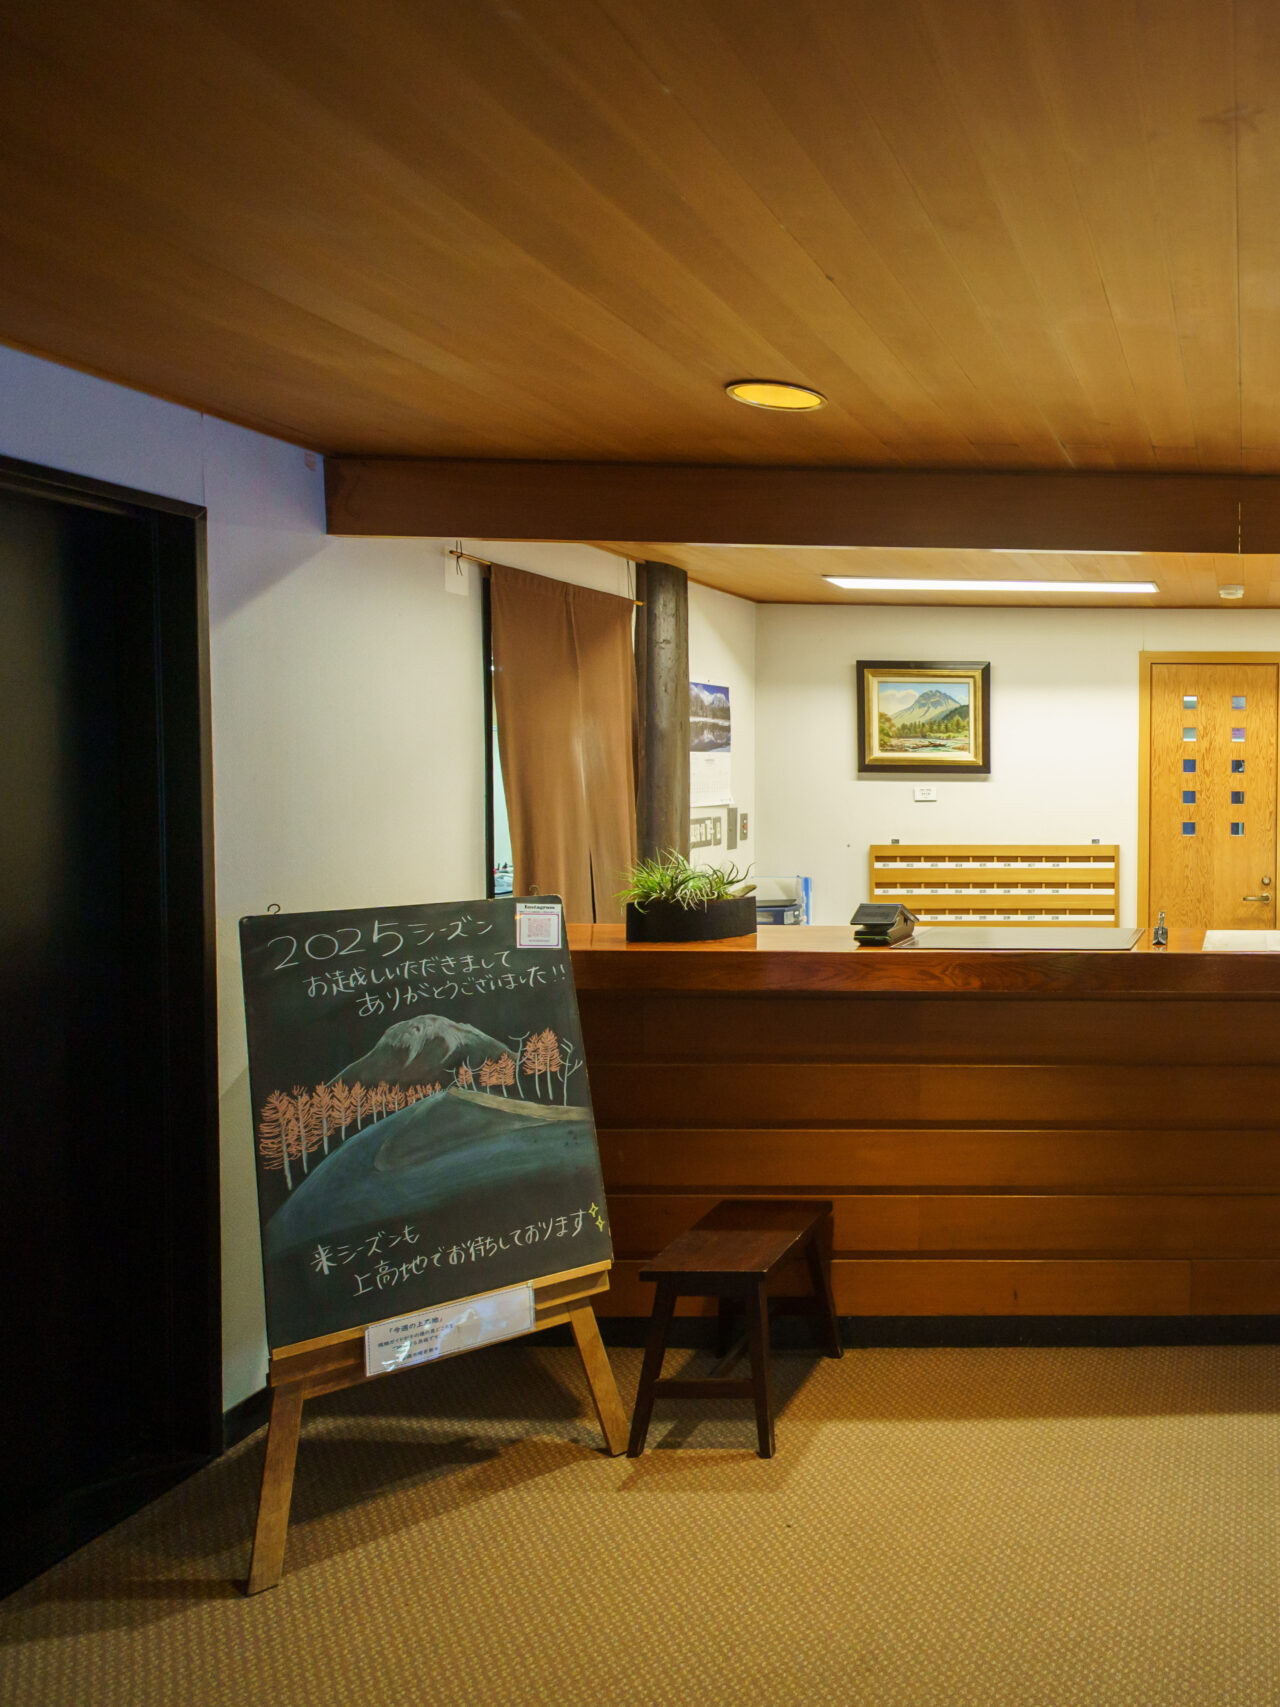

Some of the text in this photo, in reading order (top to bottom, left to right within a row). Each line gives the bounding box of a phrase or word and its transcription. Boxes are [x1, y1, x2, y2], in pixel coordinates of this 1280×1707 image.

[303, 950, 511, 997] お越しいただきまして
[310, 1225, 420, 1275] 来シーズンも
[353, 1209, 587, 1296] 上高地でお待ちしております
